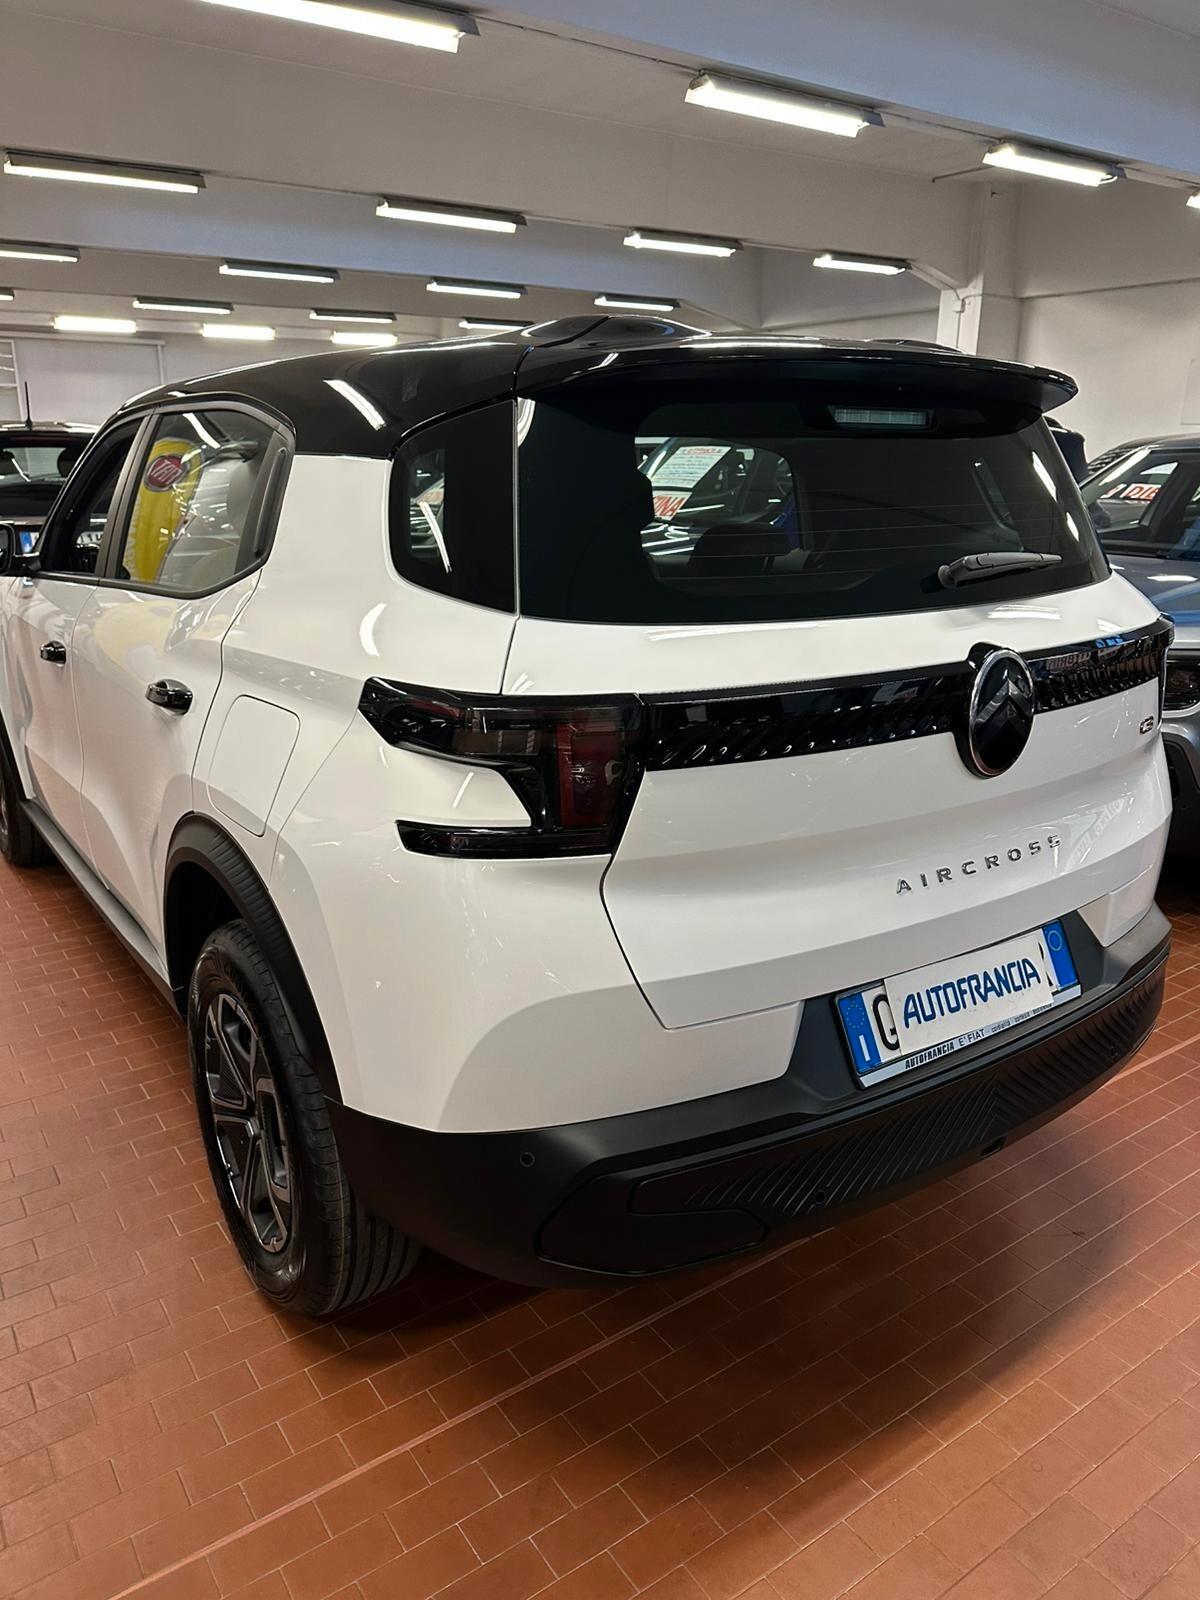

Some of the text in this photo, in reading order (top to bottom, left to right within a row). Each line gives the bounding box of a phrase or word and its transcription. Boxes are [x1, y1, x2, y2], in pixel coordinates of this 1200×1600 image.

[896, 834, 1062, 895] AIRCROSS
[903, 957, 1042, 1029] AUTOFRANCIA
[905, 1041, 955, 1070] AUTOFRANCIA
